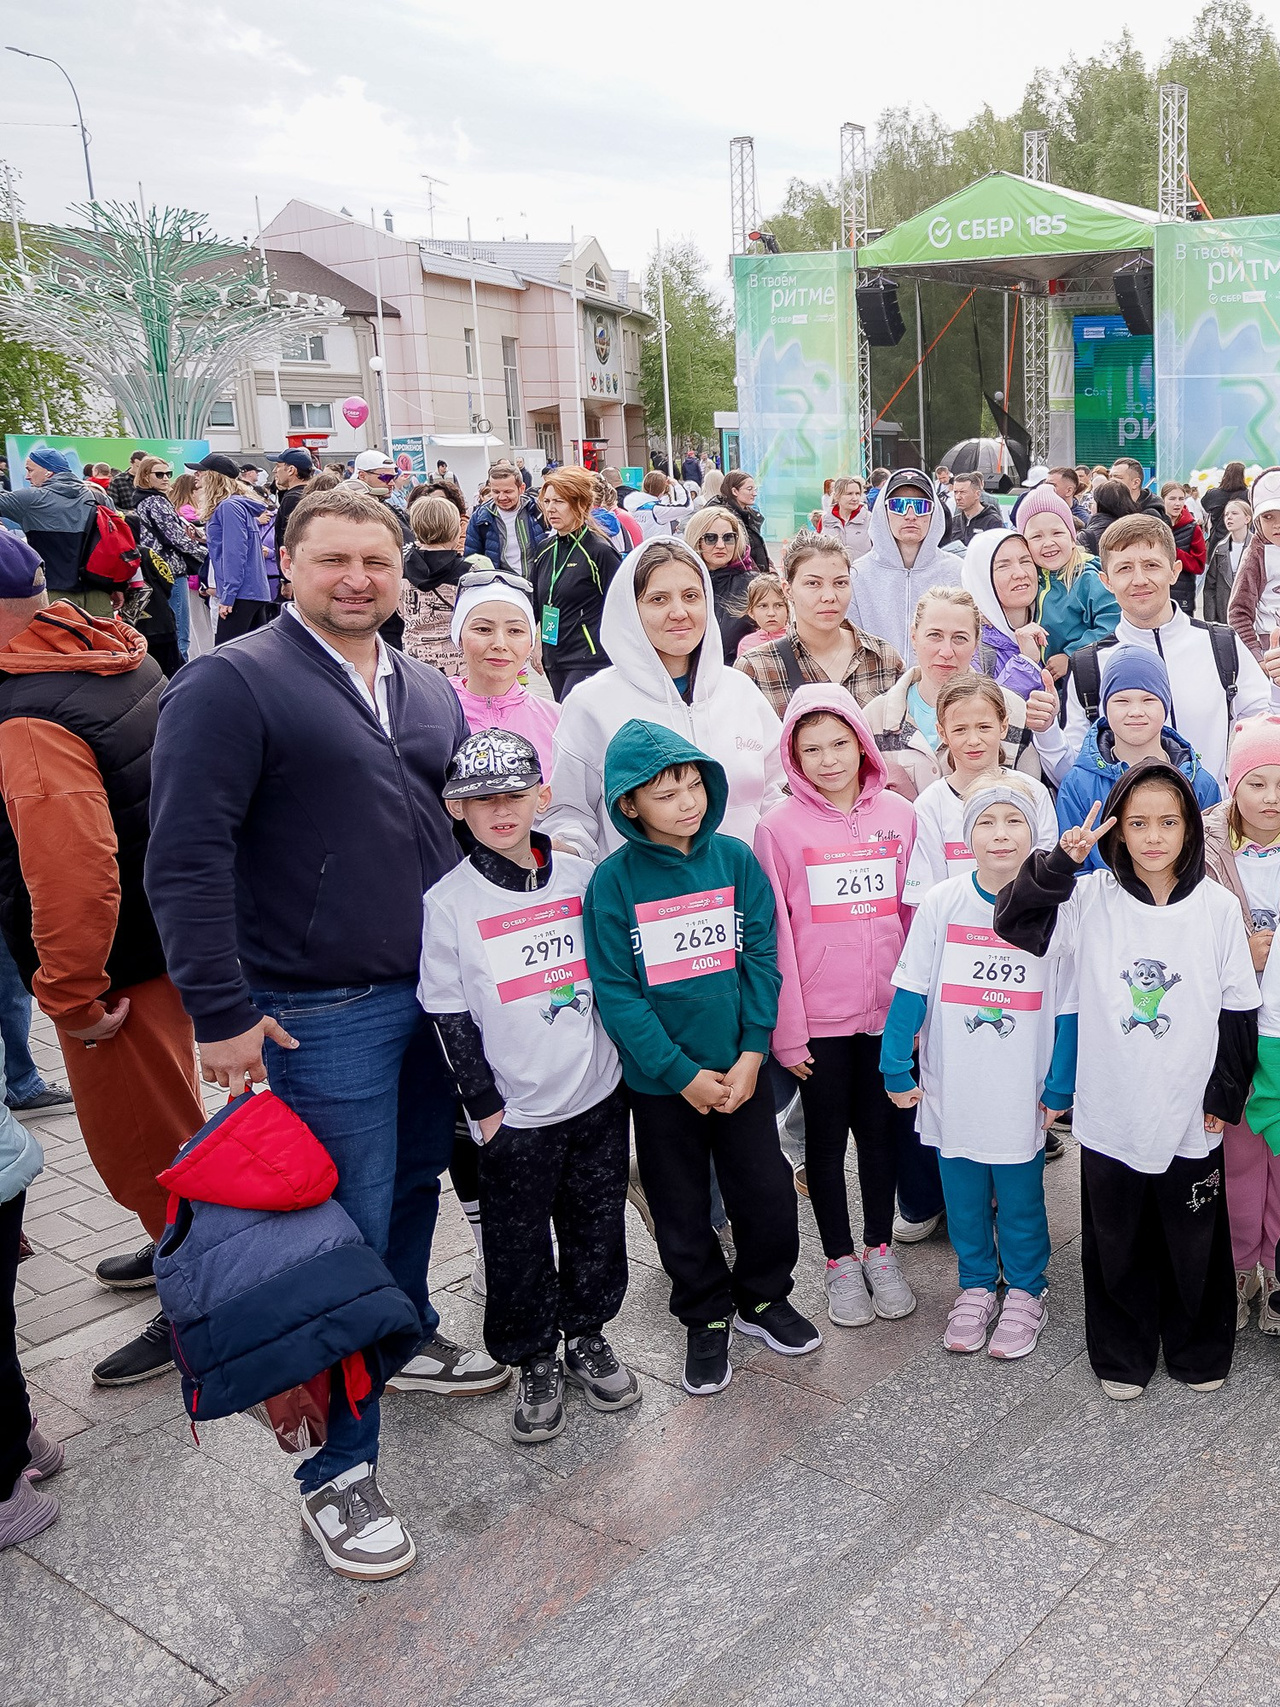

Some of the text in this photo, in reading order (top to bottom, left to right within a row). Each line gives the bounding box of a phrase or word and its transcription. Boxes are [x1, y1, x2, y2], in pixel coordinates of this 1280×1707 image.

[957, 214, 1068, 241] СБЕР 185
[1175, 242, 1243, 260] В твоём
[749, 272, 797, 288] В твоём
[771, 286, 835, 313] ритме
[1220, 294, 1242, 303] СБЕР
[836, 873, 884, 896] 2613
[545, 929, 556, 937] ЛЕТ
[673, 923, 727, 952] 2628
[521, 934, 574, 966] 2979
[972, 961, 1026, 984] 2693
